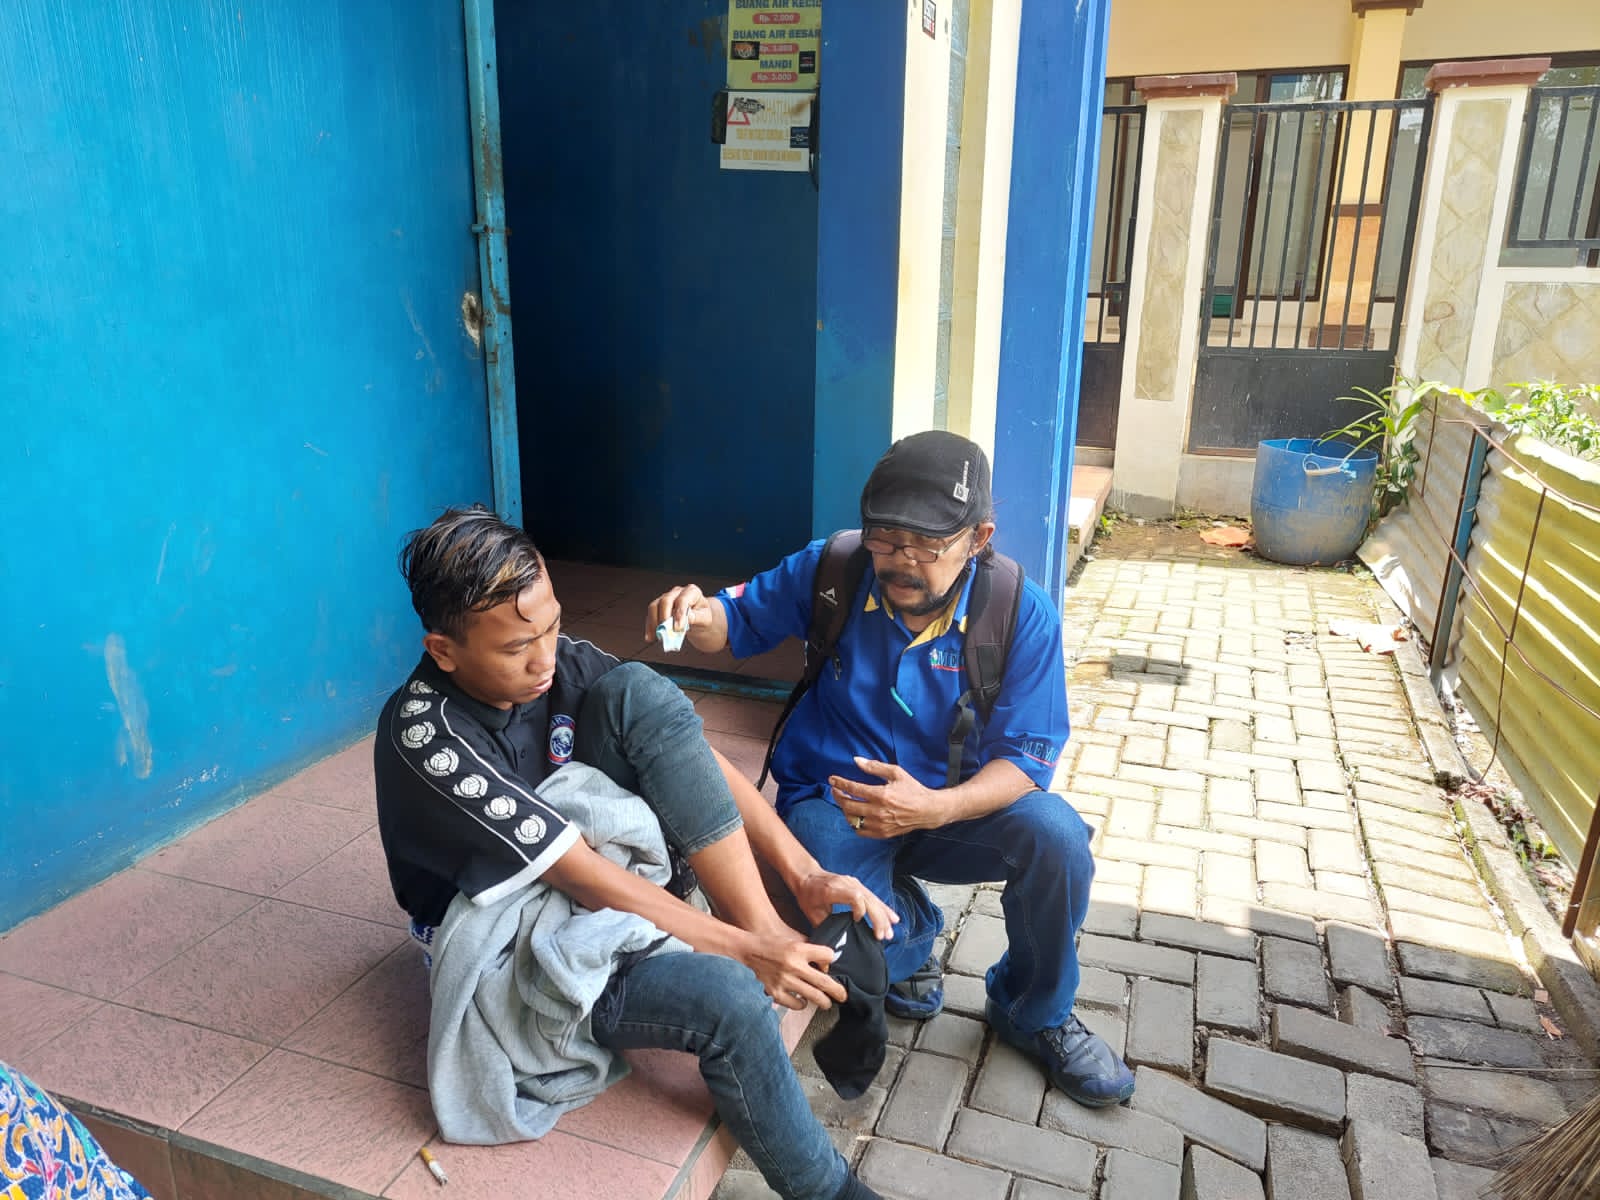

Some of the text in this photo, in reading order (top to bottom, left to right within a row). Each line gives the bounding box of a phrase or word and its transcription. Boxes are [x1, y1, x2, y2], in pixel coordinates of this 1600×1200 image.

[735, 0, 769, 9] BUANG
[771, 0, 789, 9] AIR
[733, 29, 766, 39] BUANG
[769, 29, 786, 39] AIR
[759, 59, 792, 69] MANDI
